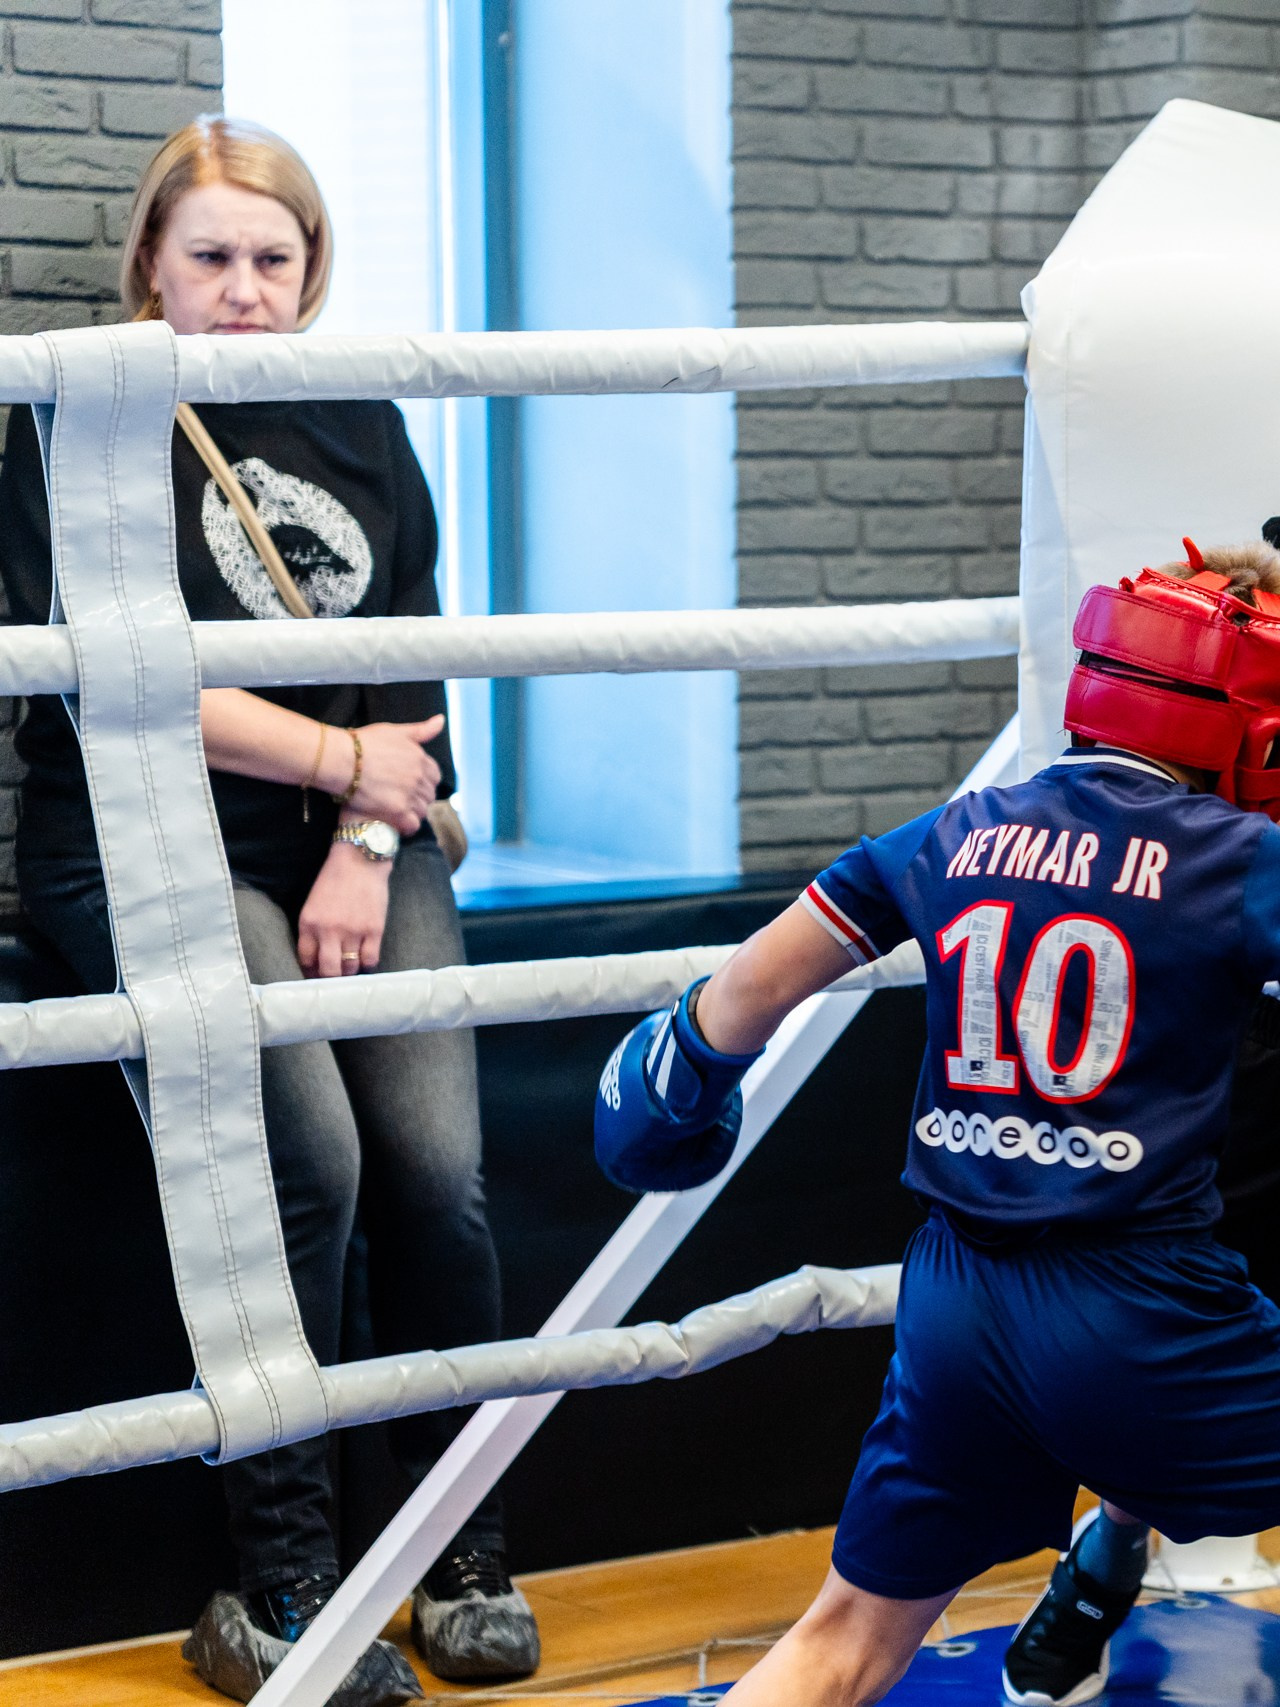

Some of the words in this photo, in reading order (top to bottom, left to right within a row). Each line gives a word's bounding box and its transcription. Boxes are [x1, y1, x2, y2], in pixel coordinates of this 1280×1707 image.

[946, 824, 1099, 887] NEYMAR
[1112, 837, 1169, 900] JR
[935, 899, 1136, 1105] 10
[915, 1107, 1143, 1172] ooredoo
